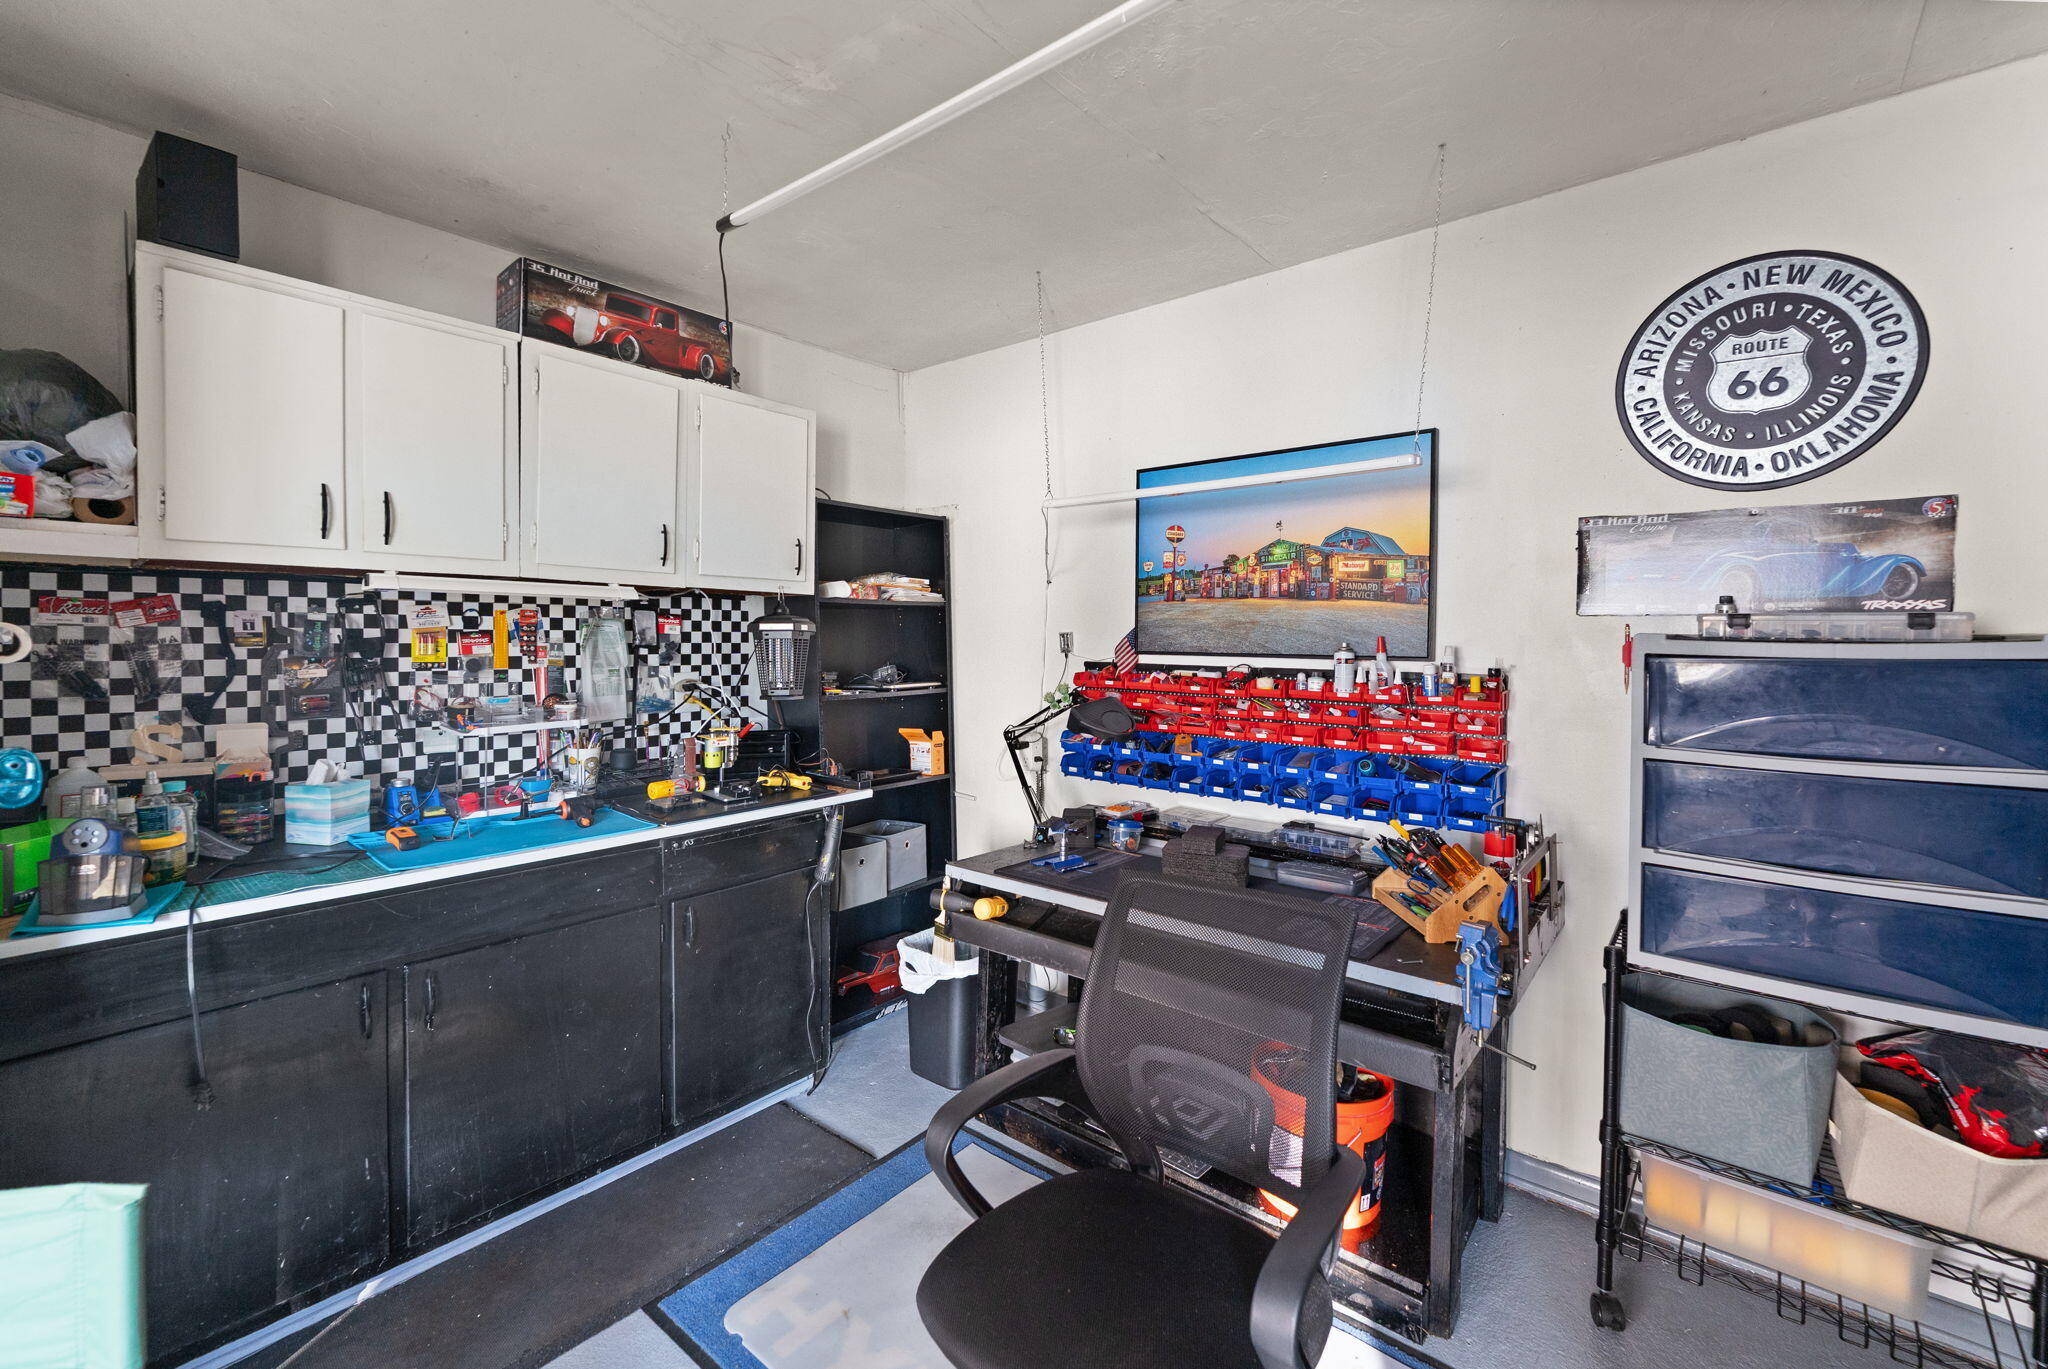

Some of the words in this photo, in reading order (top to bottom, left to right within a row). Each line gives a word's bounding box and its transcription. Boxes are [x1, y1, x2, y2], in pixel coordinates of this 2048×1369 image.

[550, 267, 573, 281] Hot
[575, 275, 599, 290] Rod
[568, 284, 598, 297] Truck
[1742, 263, 1816, 291] NEW
[1821, 268, 1908, 348] MEXICO
[1634, 285, 1723, 379] ARIZONA
[1674, 300, 1777, 373] MISSOURI
[1731, 336, 1789, 356] ROUTE
[1796, 303, 1854, 355] TEXAS
[1727, 366, 1790, 400] 66
[1673, 390, 1735, 442] KANSAS
[1765, 374, 1852, 442] ILLINOIS
[1771, 370, 1905, 474] OKLAHOMA
[1632, 396, 1750, 478] CALIFORNIA
[1260, 552, 1297, 562] SINCLAIR
[1340, 581, 1378, 591] STANDARD
[1343, 590, 1375, 600] SERVICE
[1861, 599, 1948, 610] TRAXXAS
